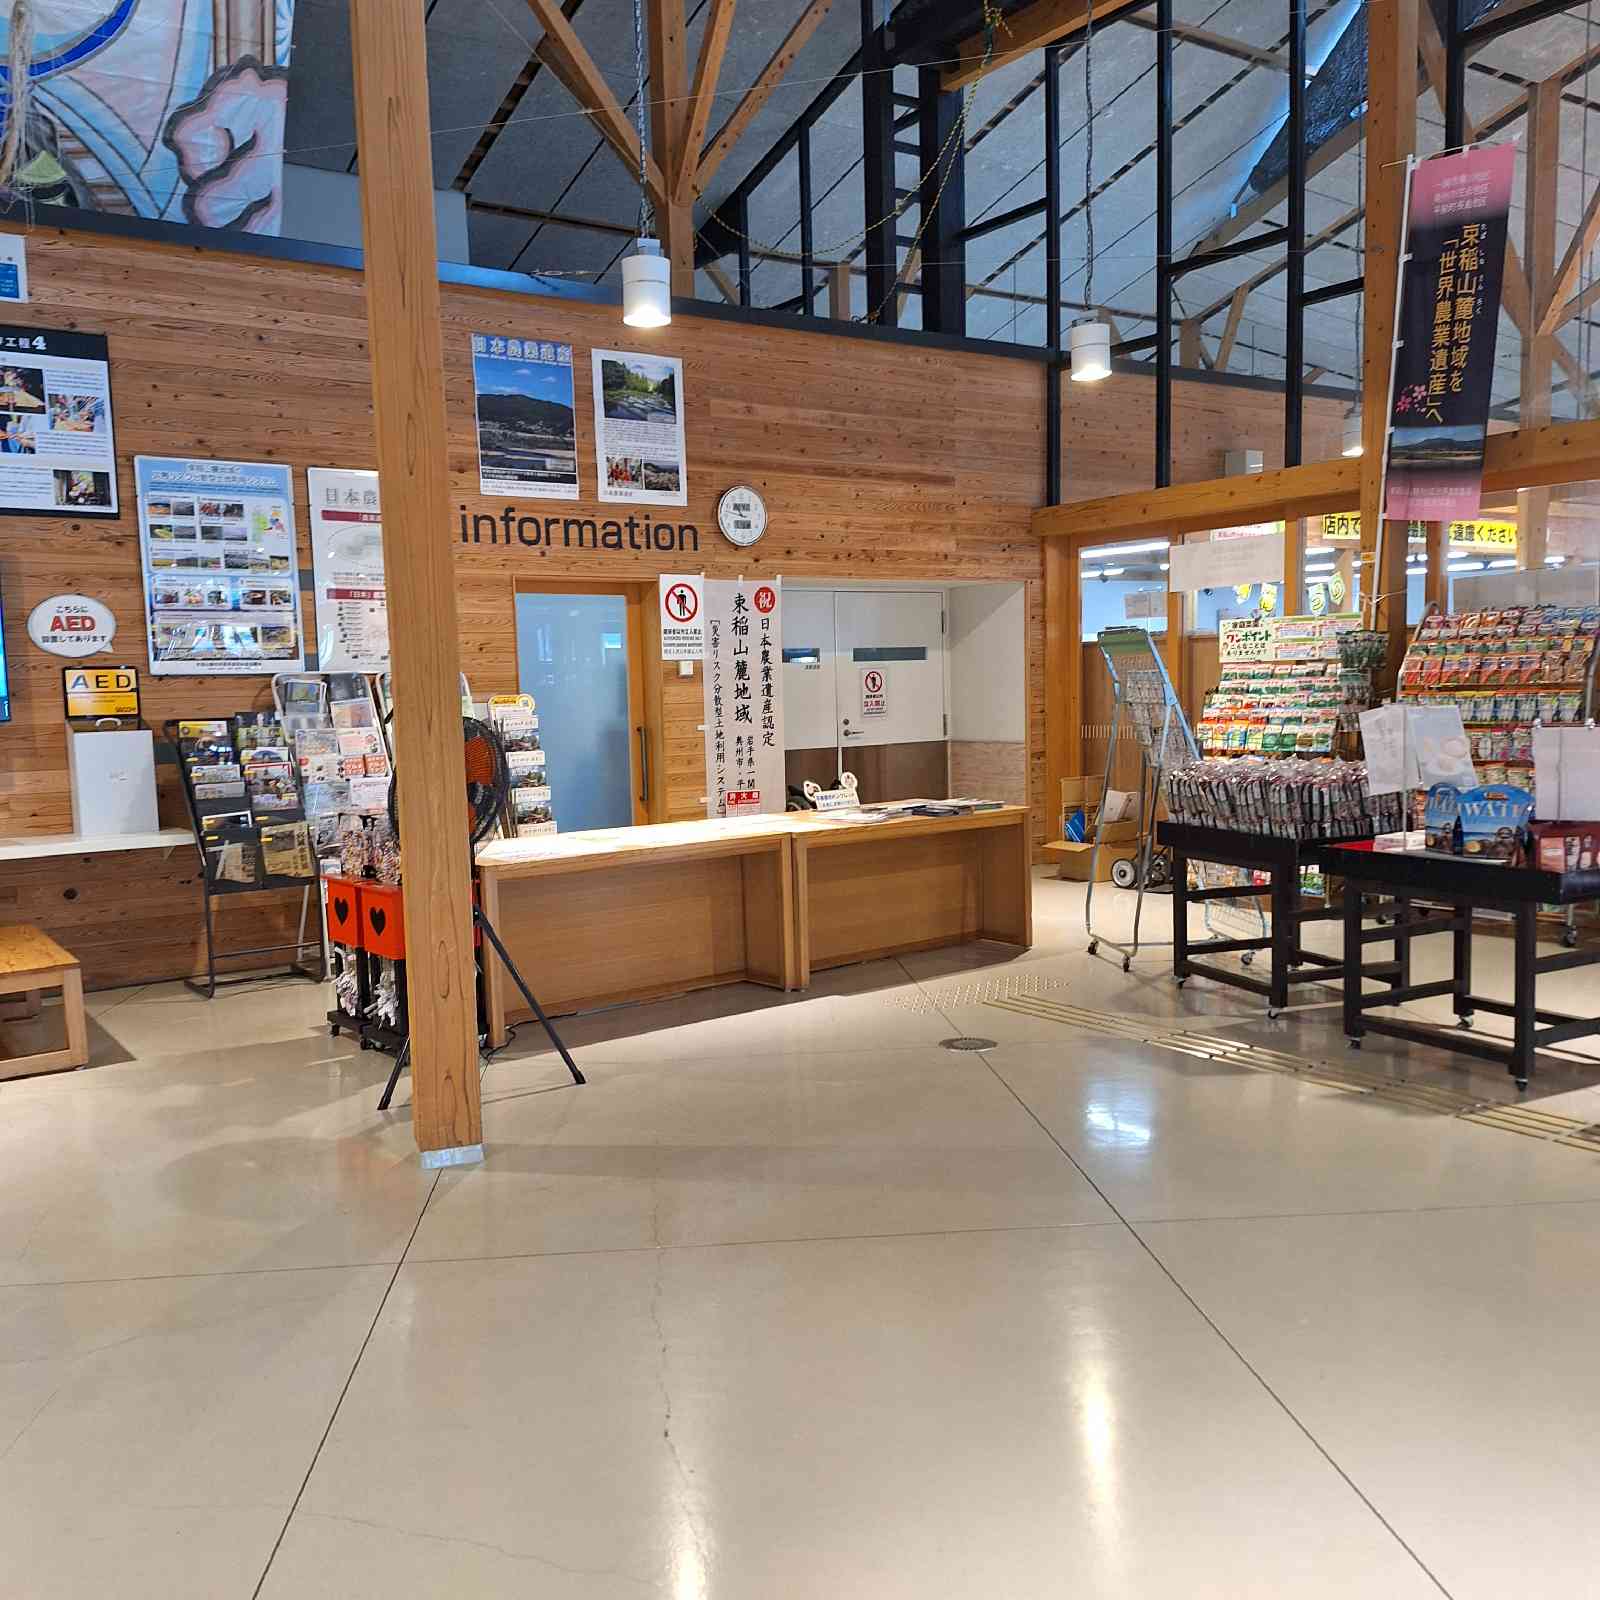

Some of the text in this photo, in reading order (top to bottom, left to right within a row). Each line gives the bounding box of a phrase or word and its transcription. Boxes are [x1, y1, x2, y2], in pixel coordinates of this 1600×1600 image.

[459, 504, 699, 551] information
[50, 615, 96, 632] AED
[71, 674, 131, 689] AED
[760, 617, 776, 747] 日本農業遺産認定
